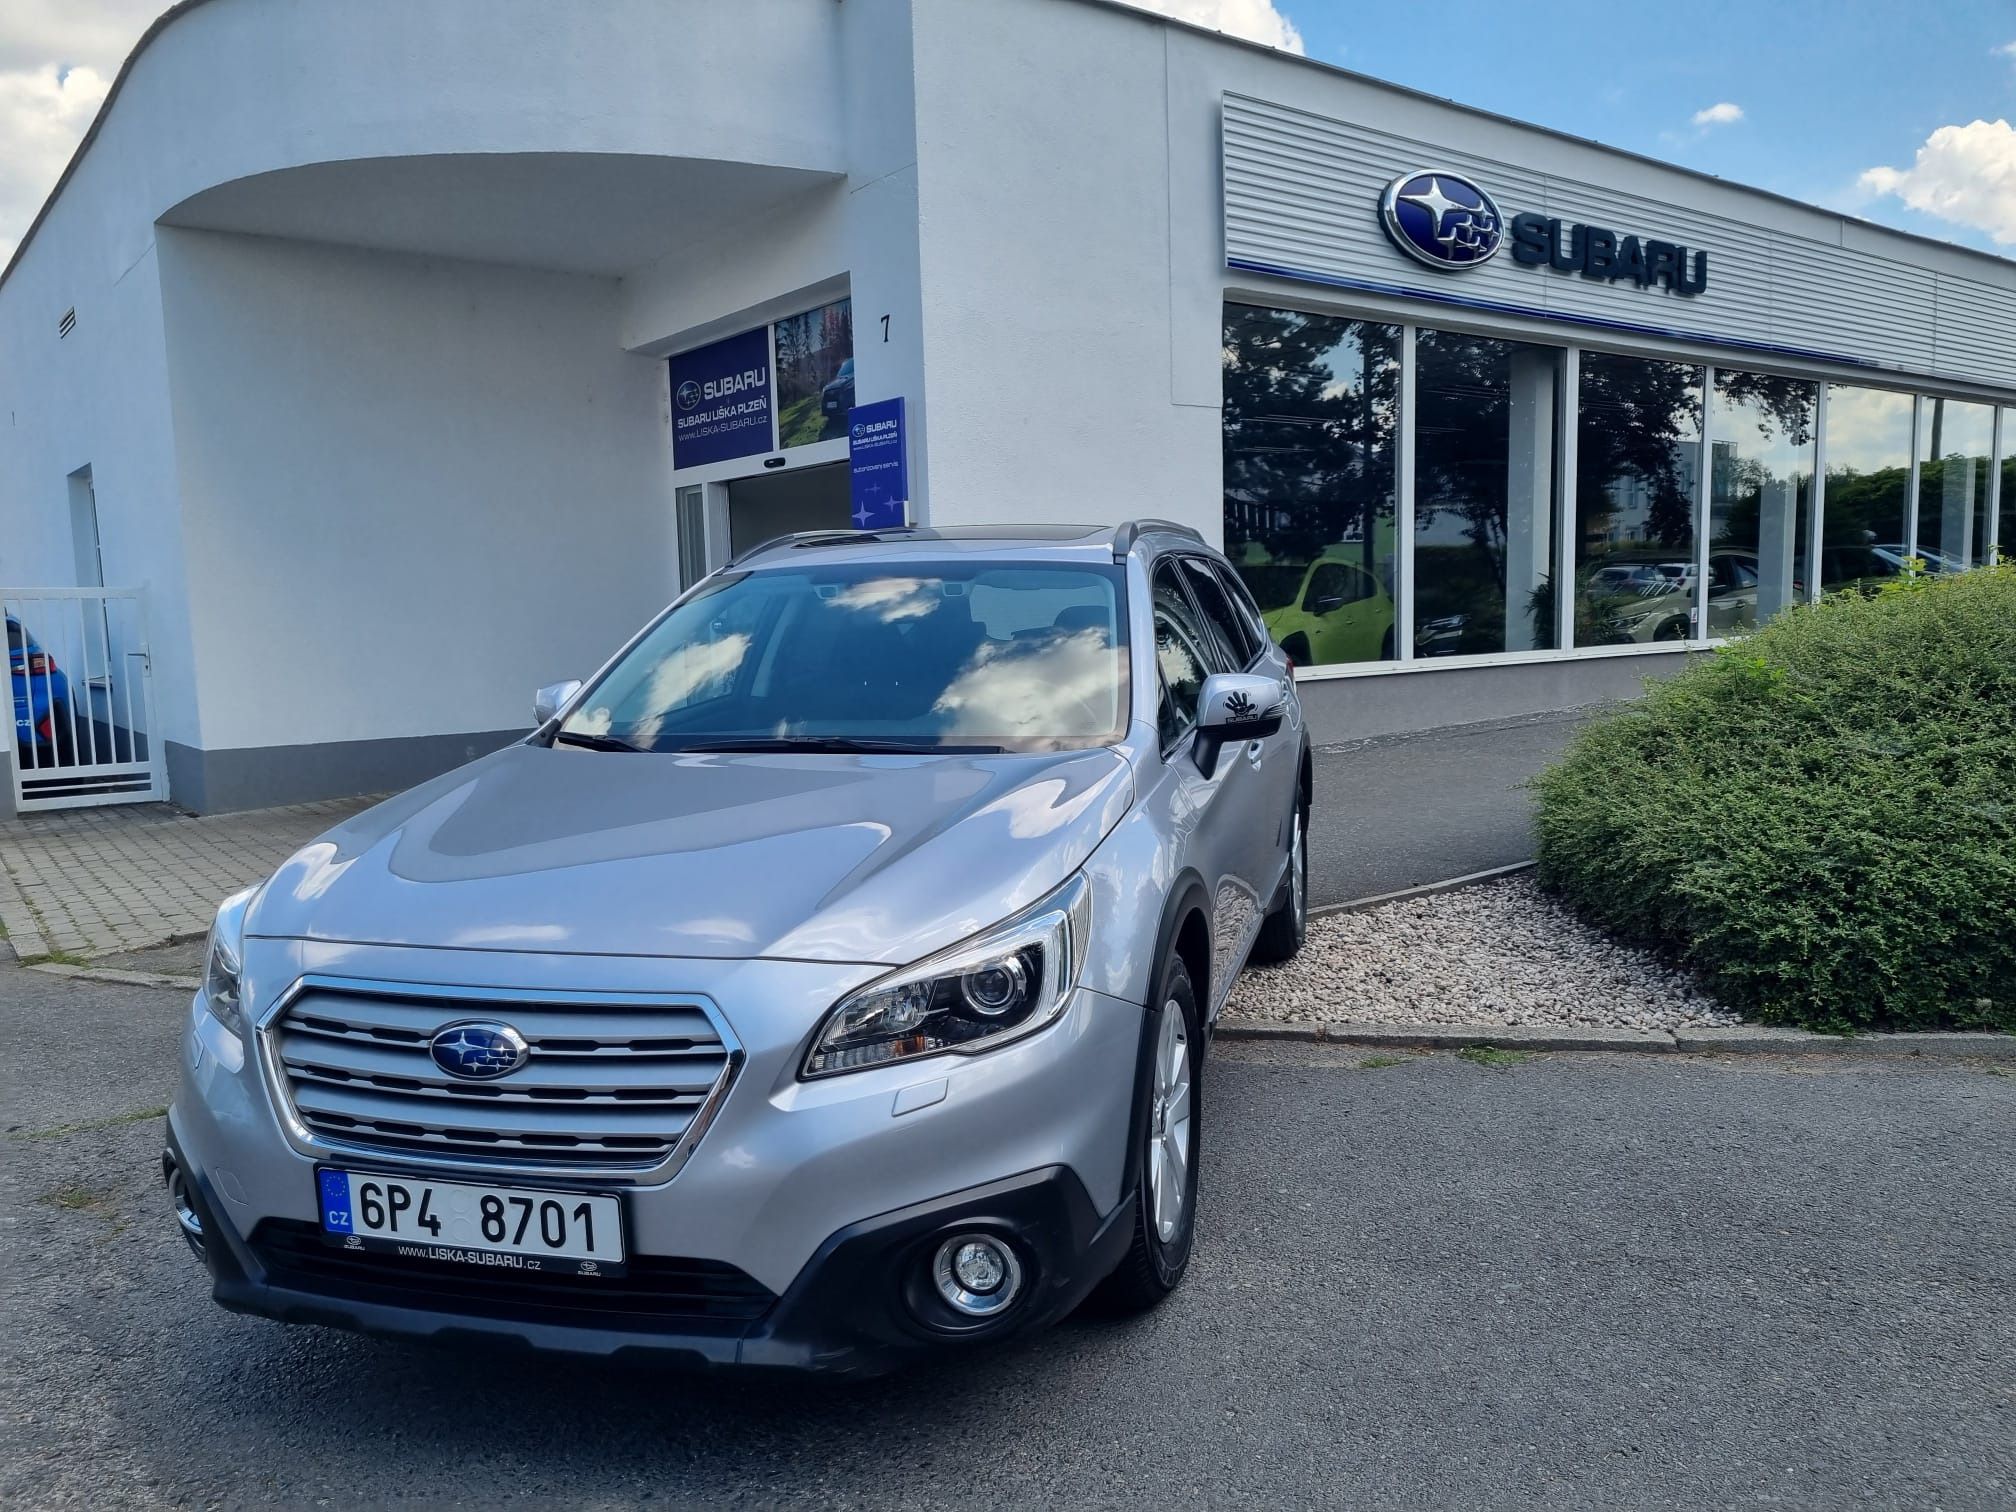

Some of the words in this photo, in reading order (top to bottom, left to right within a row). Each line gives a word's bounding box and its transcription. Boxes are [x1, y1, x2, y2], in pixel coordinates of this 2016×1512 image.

[1511, 212, 1708, 294] SUBARU
[880, 313, 890, 343] 7
[703, 366, 766, 400] SUBARU
[677, 411, 712, 429] SUBARU
[712, 405, 737, 421] LIŠKA
[738, 394, 767, 415] PLZEŇ
[866, 419, 897, 433] SUBARU
[329, 1210, 349, 1226] CZ
[359, 1181, 442, 1237] 6P4
[479, 1194, 595, 1253] 8701
